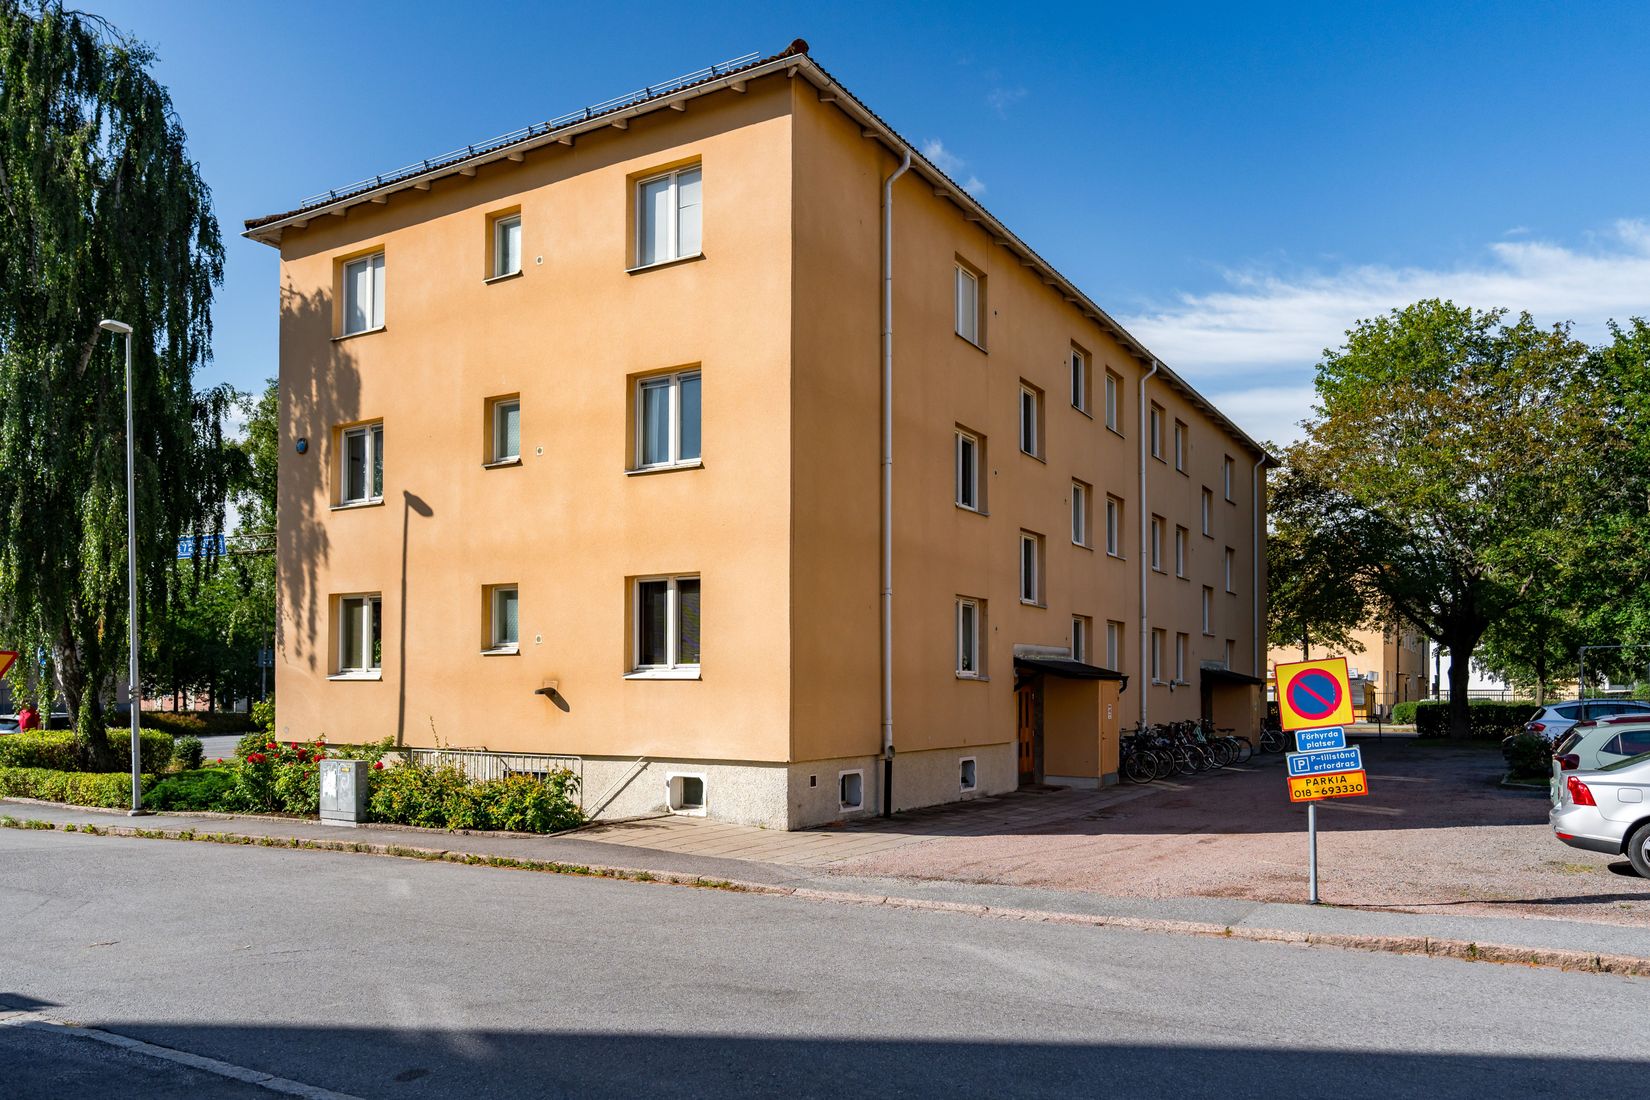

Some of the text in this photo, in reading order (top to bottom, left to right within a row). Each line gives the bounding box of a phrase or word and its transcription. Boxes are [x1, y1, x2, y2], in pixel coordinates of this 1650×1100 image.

[1301, 731, 1338, 740] Förhyrda
[1306, 740, 1336, 749] platser
[1310, 751, 1356, 762] P-tillstånd
[1314, 762, 1356, 770] erfordras
[1305, 775, 1347, 787] PARKIA
[1294, 784, 1363, 798] 018-693330
